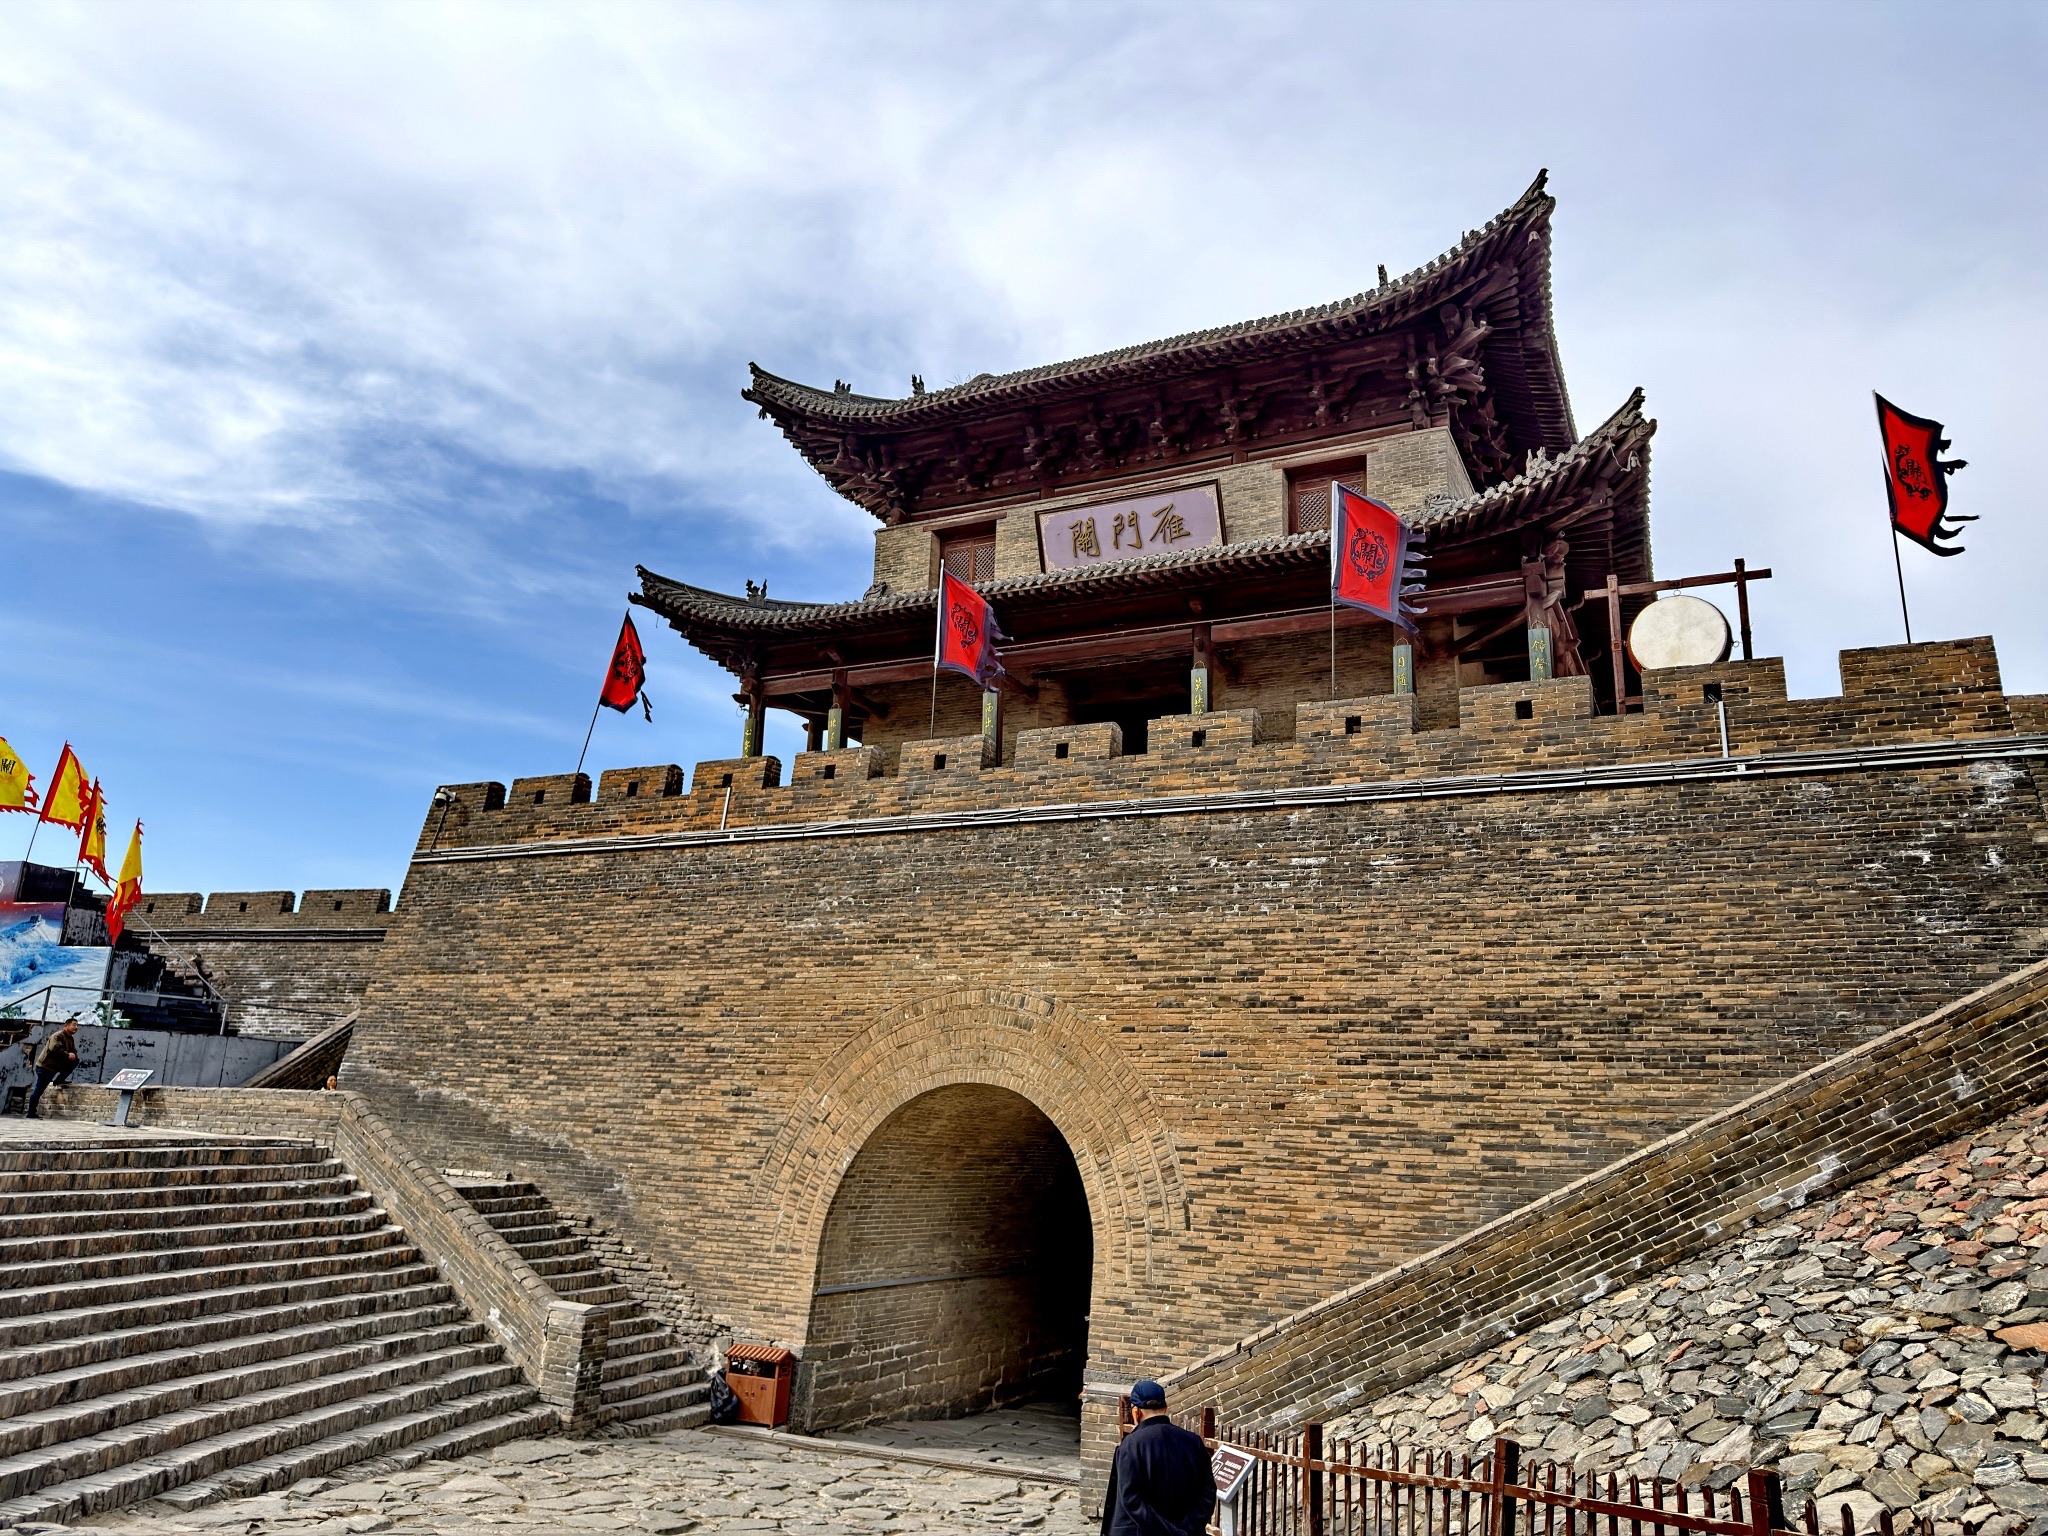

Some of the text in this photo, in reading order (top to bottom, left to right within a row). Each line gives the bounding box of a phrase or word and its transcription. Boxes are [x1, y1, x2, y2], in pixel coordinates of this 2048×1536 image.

[1068, 503, 1191, 558] 雁門關
[1360, 543, 1378, 568] 關
